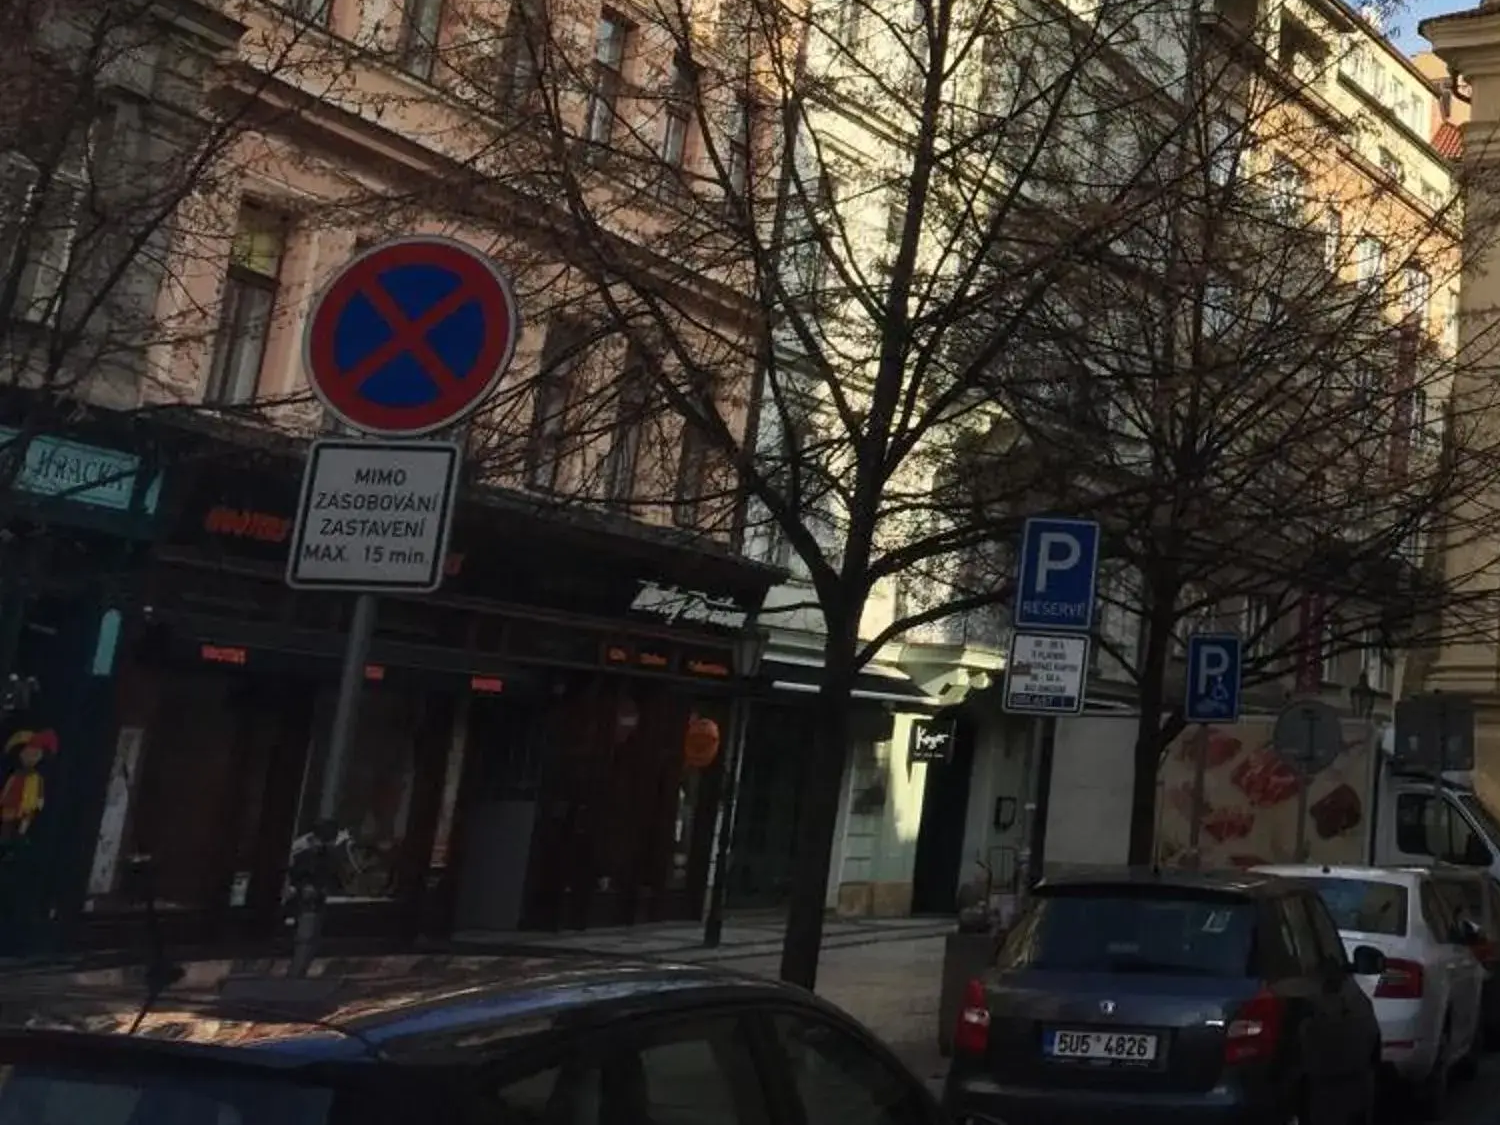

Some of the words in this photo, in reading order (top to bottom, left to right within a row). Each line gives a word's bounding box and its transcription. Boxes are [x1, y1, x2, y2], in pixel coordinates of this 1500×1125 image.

[354, 468, 407, 486] MIMO
[319, 517, 427, 538] ZASTAVENÍ
[364, 545, 384, 563] 15
[1035, 532, 1081, 593] P
[1197, 645, 1230, 695] P
[1058, 1034, 1091, 1054] 5U5
[1104, 1034, 1148, 1057] 4826
